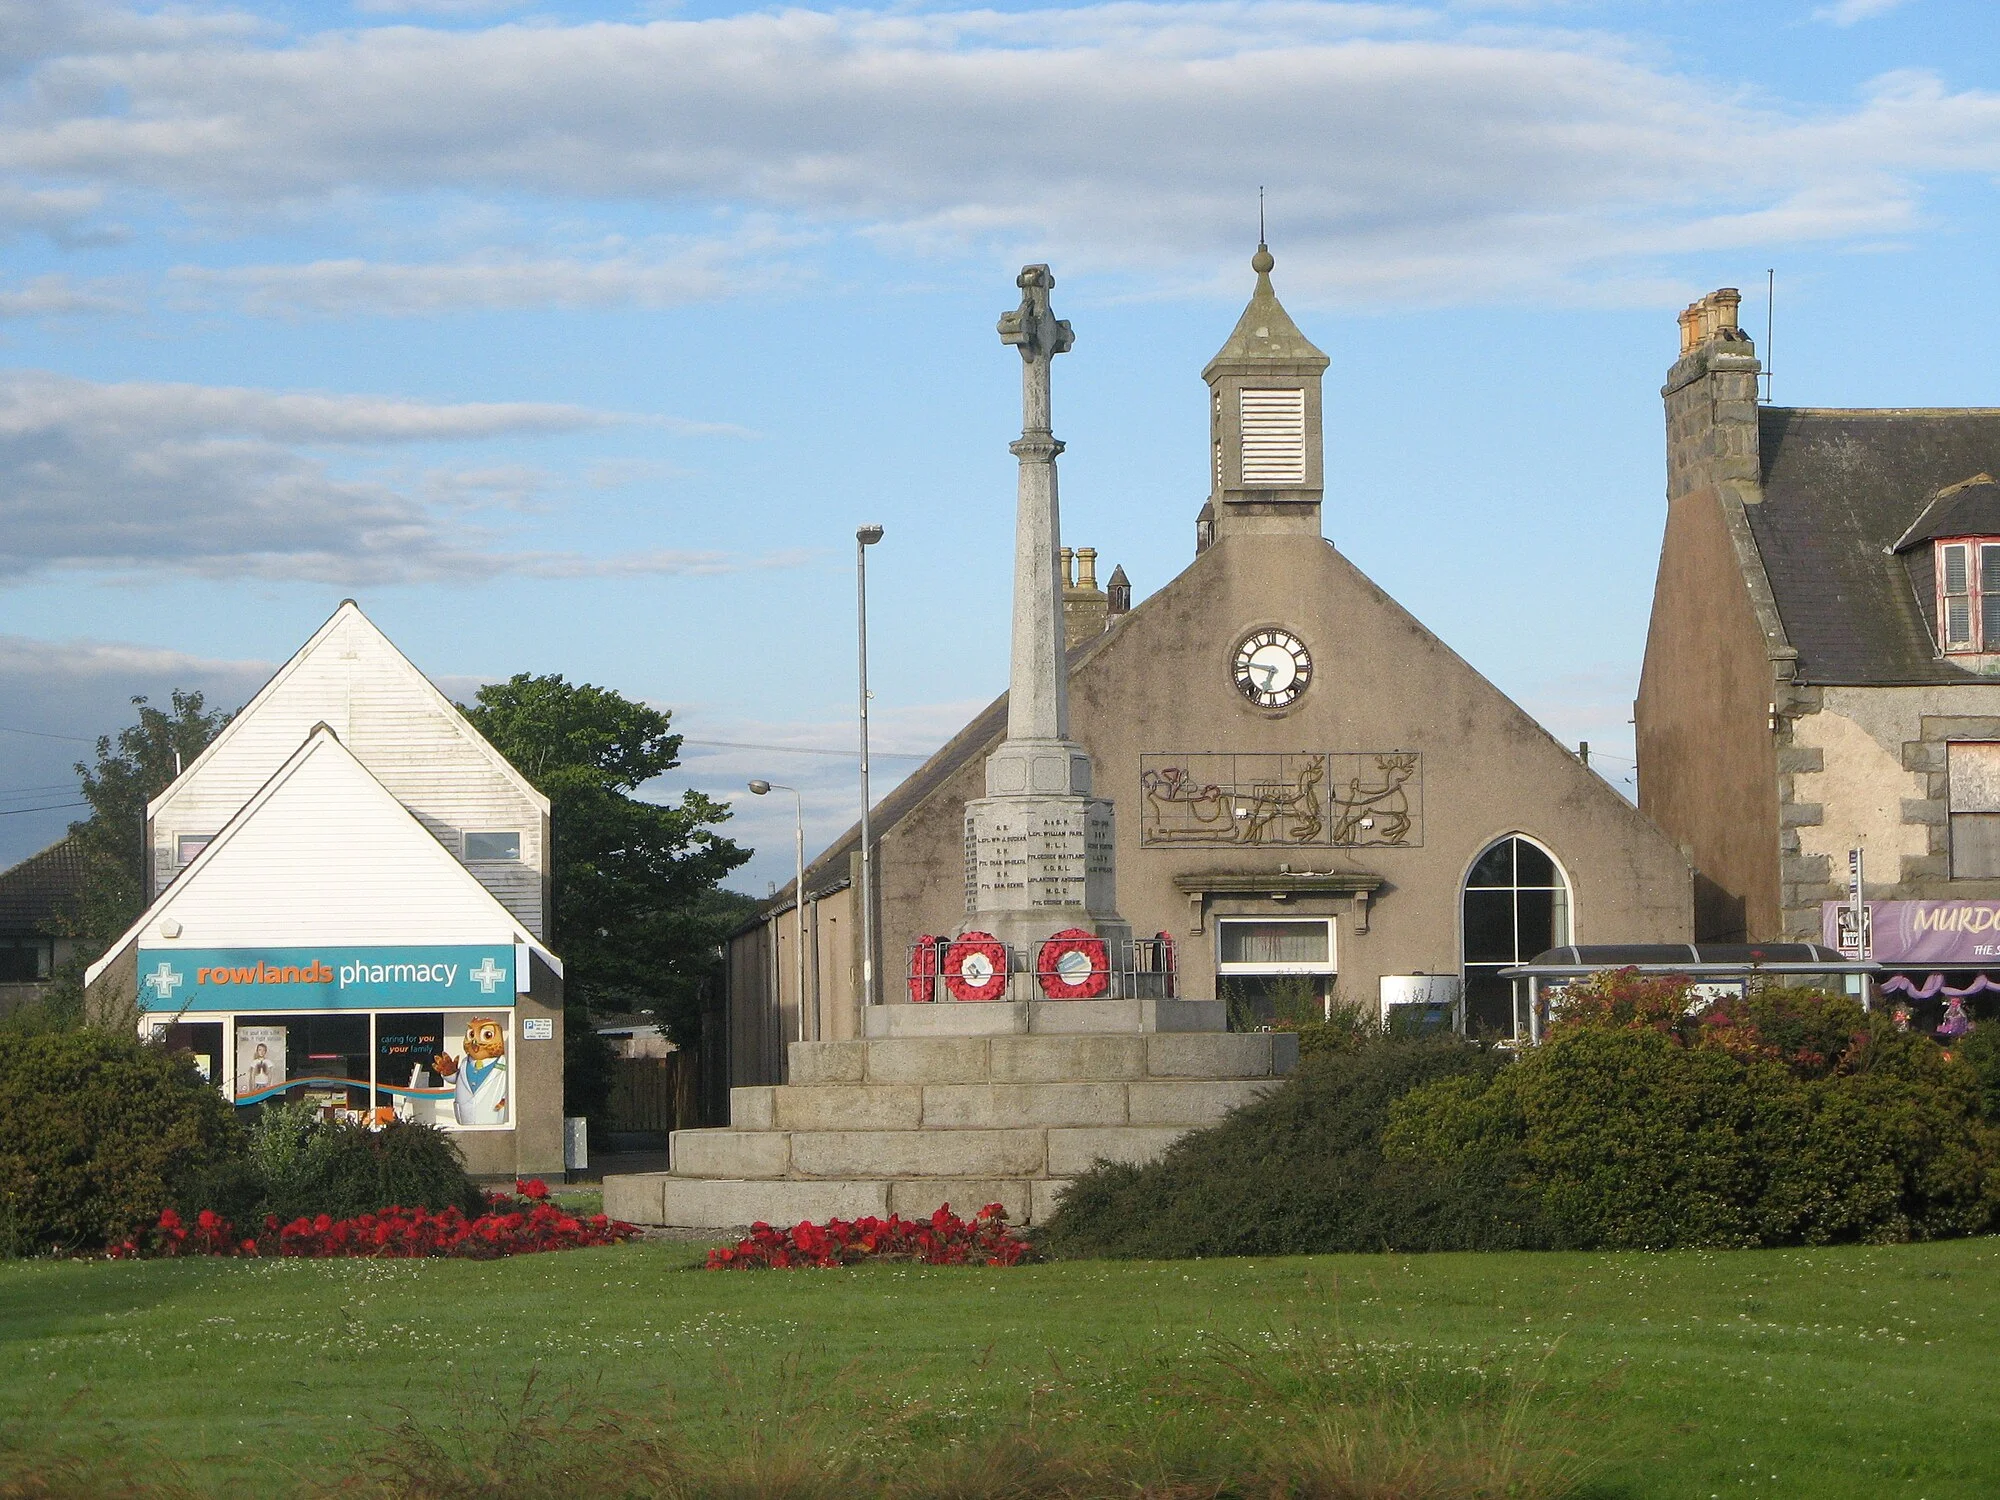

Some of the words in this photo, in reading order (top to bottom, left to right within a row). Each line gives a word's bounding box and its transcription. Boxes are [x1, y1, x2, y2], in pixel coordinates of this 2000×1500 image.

[1973, 945, 1993, 955] THE
[196, 959, 336, 985] rowlands
[339, 959, 458, 989] pharmacy
[526, 1021, 533, 1029] P
[381, 1035, 405, 1045] caring
[406, 1034, 417, 1043] for
[418, 1035, 435, 1044] you
[381, 1045, 388, 1053] &
[388, 1046, 409, 1055] your
[410, 1045, 433, 1054] family
